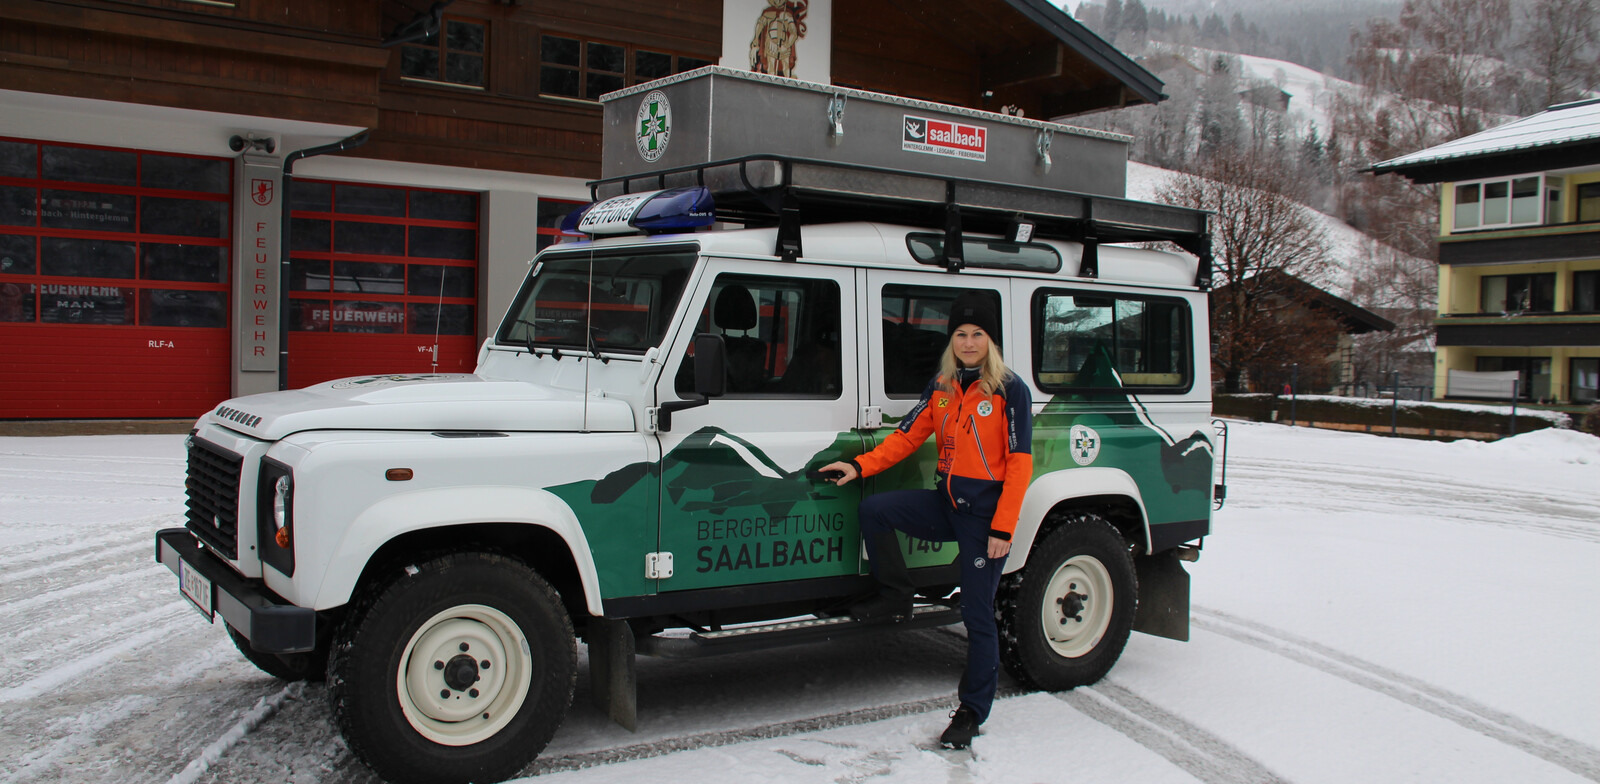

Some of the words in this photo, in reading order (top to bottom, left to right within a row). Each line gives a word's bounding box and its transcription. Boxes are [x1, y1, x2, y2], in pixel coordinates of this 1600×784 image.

[929, 123, 982, 148] saalbach
[903, 143, 934, 151] HINTERGLEMM
[936, 146, 955, 156] LEOGANG
[958, 150, 985, 160] FIEBERBRUNN
[600, 196, 641, 209] BERG
[20, 207, 63, 218] Saabach
[70, 211, 130, 222] Hinterglemm
[581, 206, 635, 226] RETTUNG
[253, 222, 268, 356] FEUERWEHR
[56, 300, 95, 309] MAN
[148, 340, 175, 348] RLF-A
[417, 345, 434, 353] VF-A
[215, 405, 263, 429] DEFENDER
[697, 512, 844, 541] BERGRETTUNG
[696, 536, 843, 573] SAALBACH
